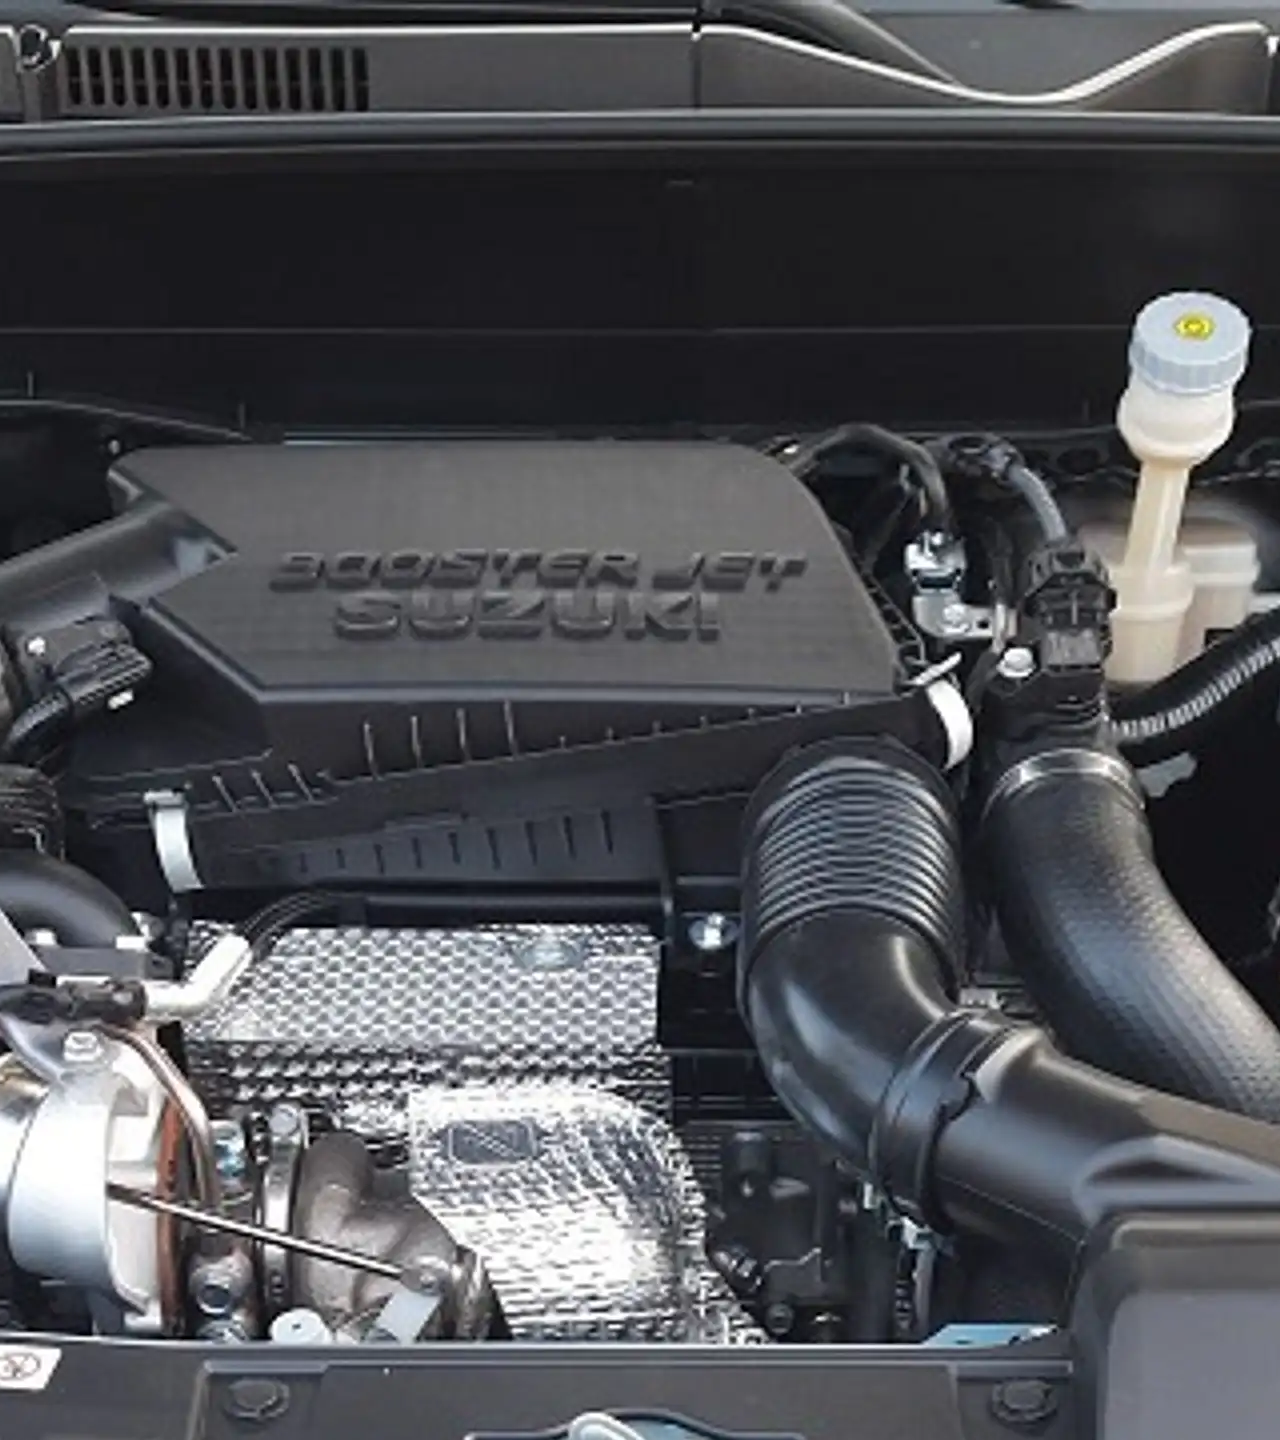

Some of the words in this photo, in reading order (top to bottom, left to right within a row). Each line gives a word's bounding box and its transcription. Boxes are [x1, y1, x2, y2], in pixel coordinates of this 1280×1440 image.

[269, 548, 639, 592] BOOSTER
[651, 550, 808, 593] JET
[333, 590, 721, 641] SUZUKI
